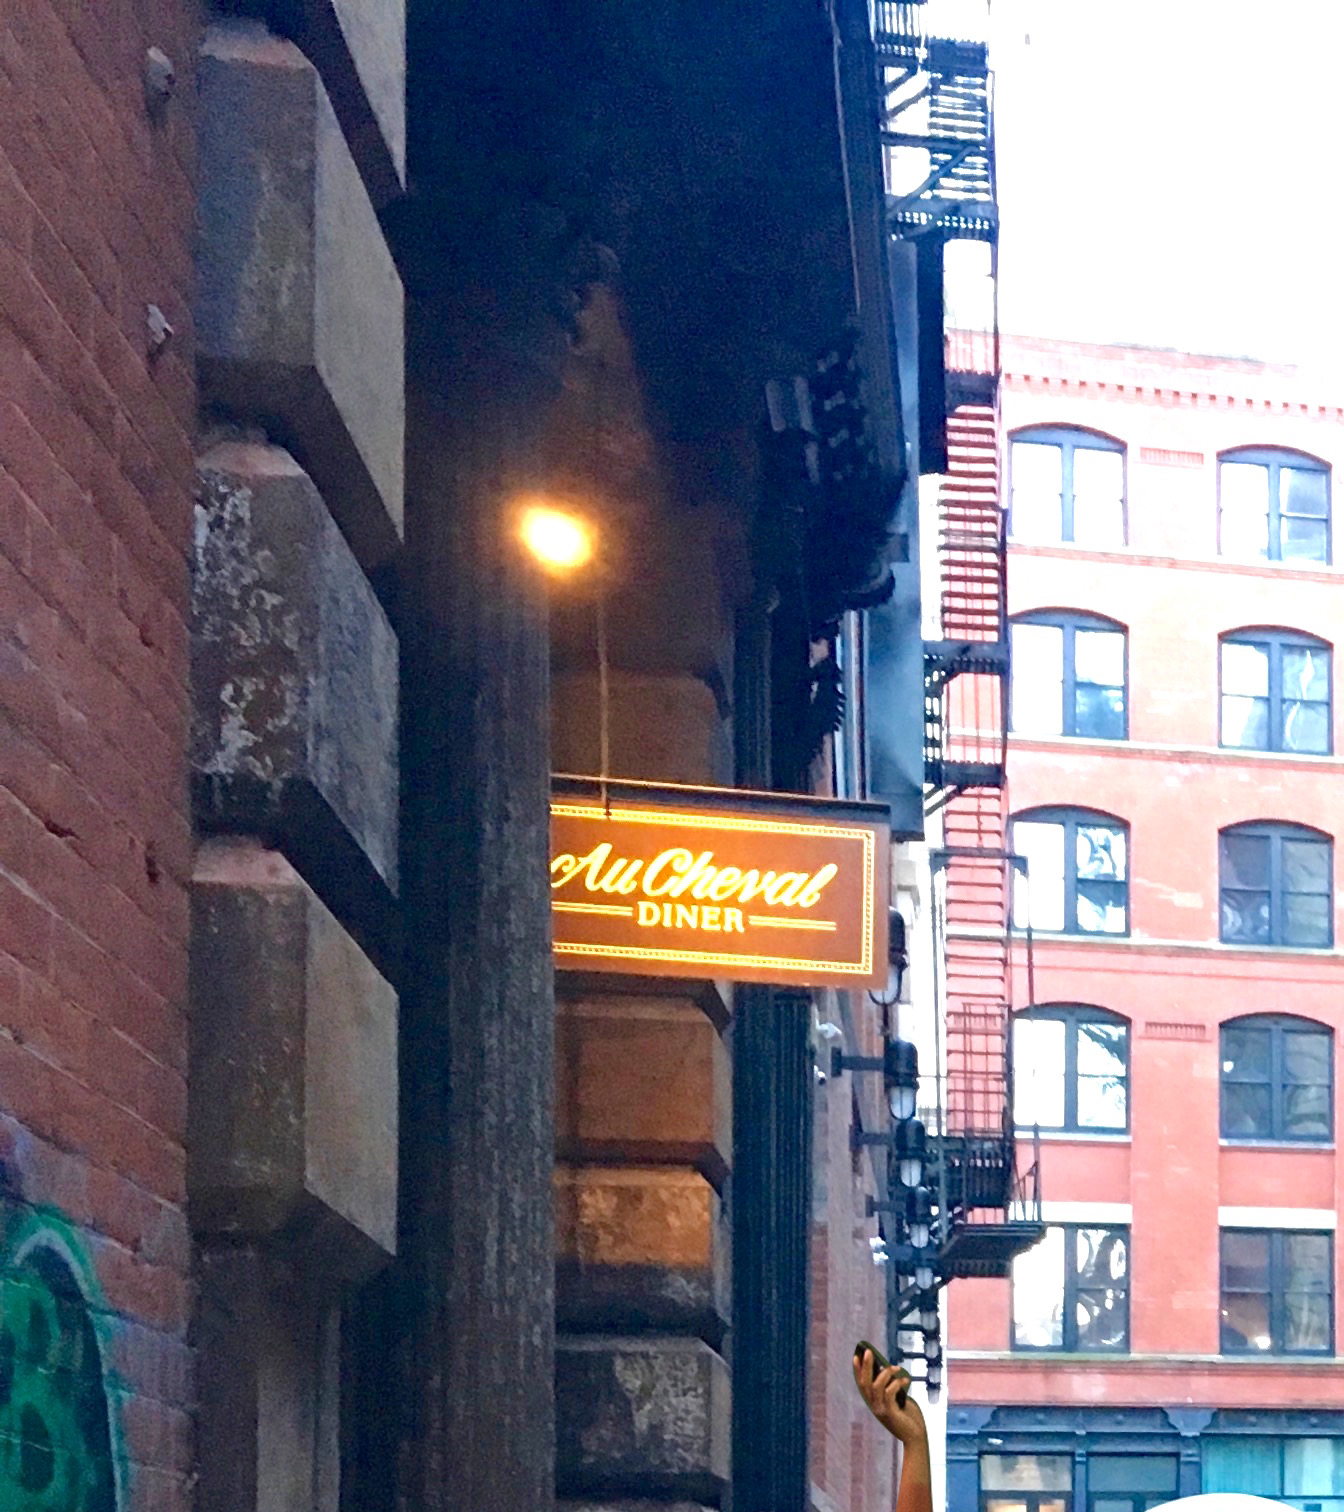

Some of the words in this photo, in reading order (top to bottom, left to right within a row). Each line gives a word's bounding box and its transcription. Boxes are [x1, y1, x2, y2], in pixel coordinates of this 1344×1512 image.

[551, 843, 644, 896] Au
[642, 848, 838, 908] Cheval
[637, 901, 745, 932] DINER
